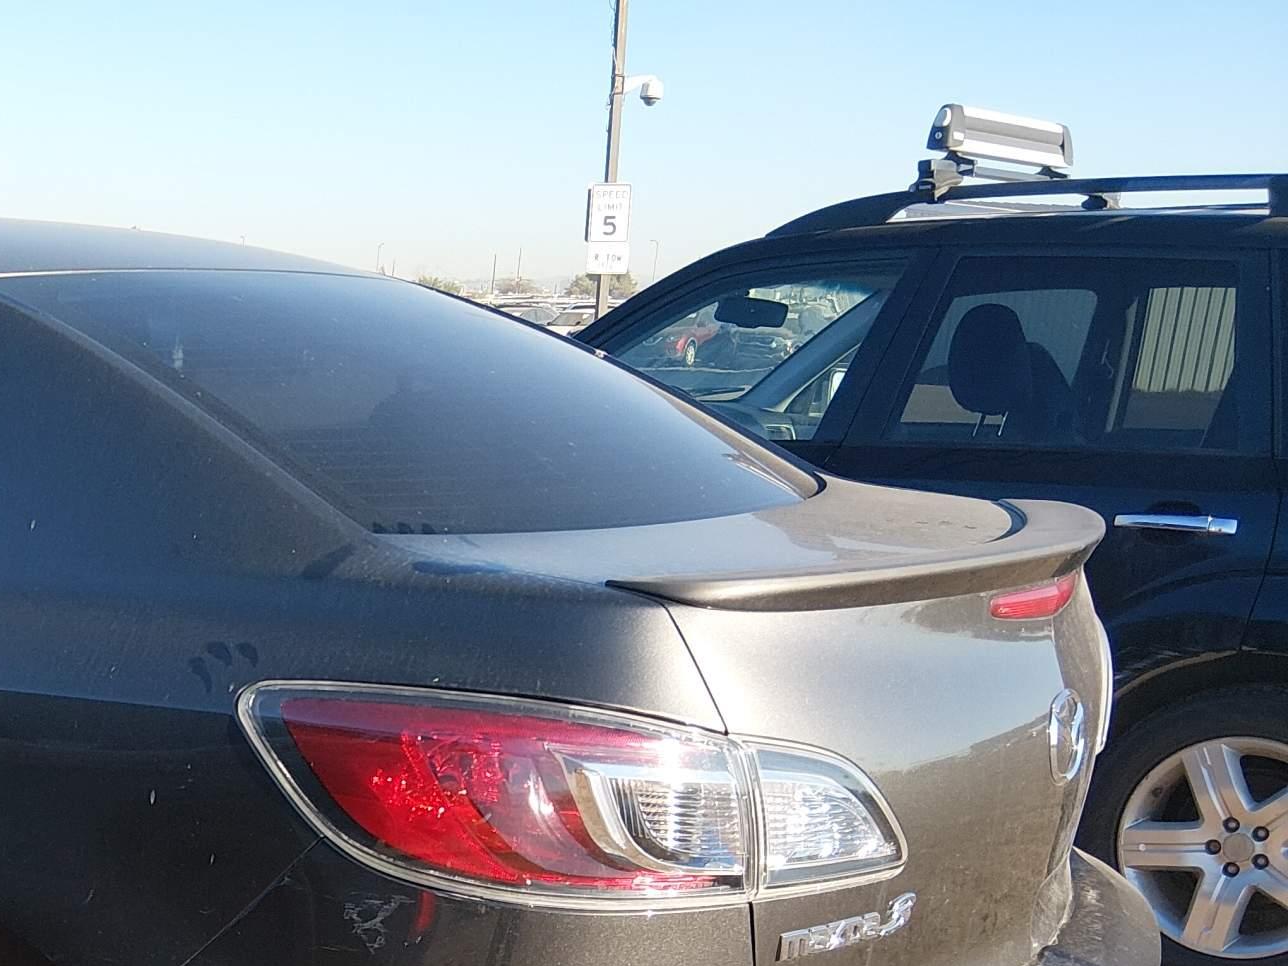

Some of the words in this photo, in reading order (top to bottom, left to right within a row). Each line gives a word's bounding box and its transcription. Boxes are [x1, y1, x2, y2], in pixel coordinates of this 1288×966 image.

[596, 190, 629, 199] SPEED
[597, 203, 623, 212] LIMIT
[602, 215, 617, 236] 5
